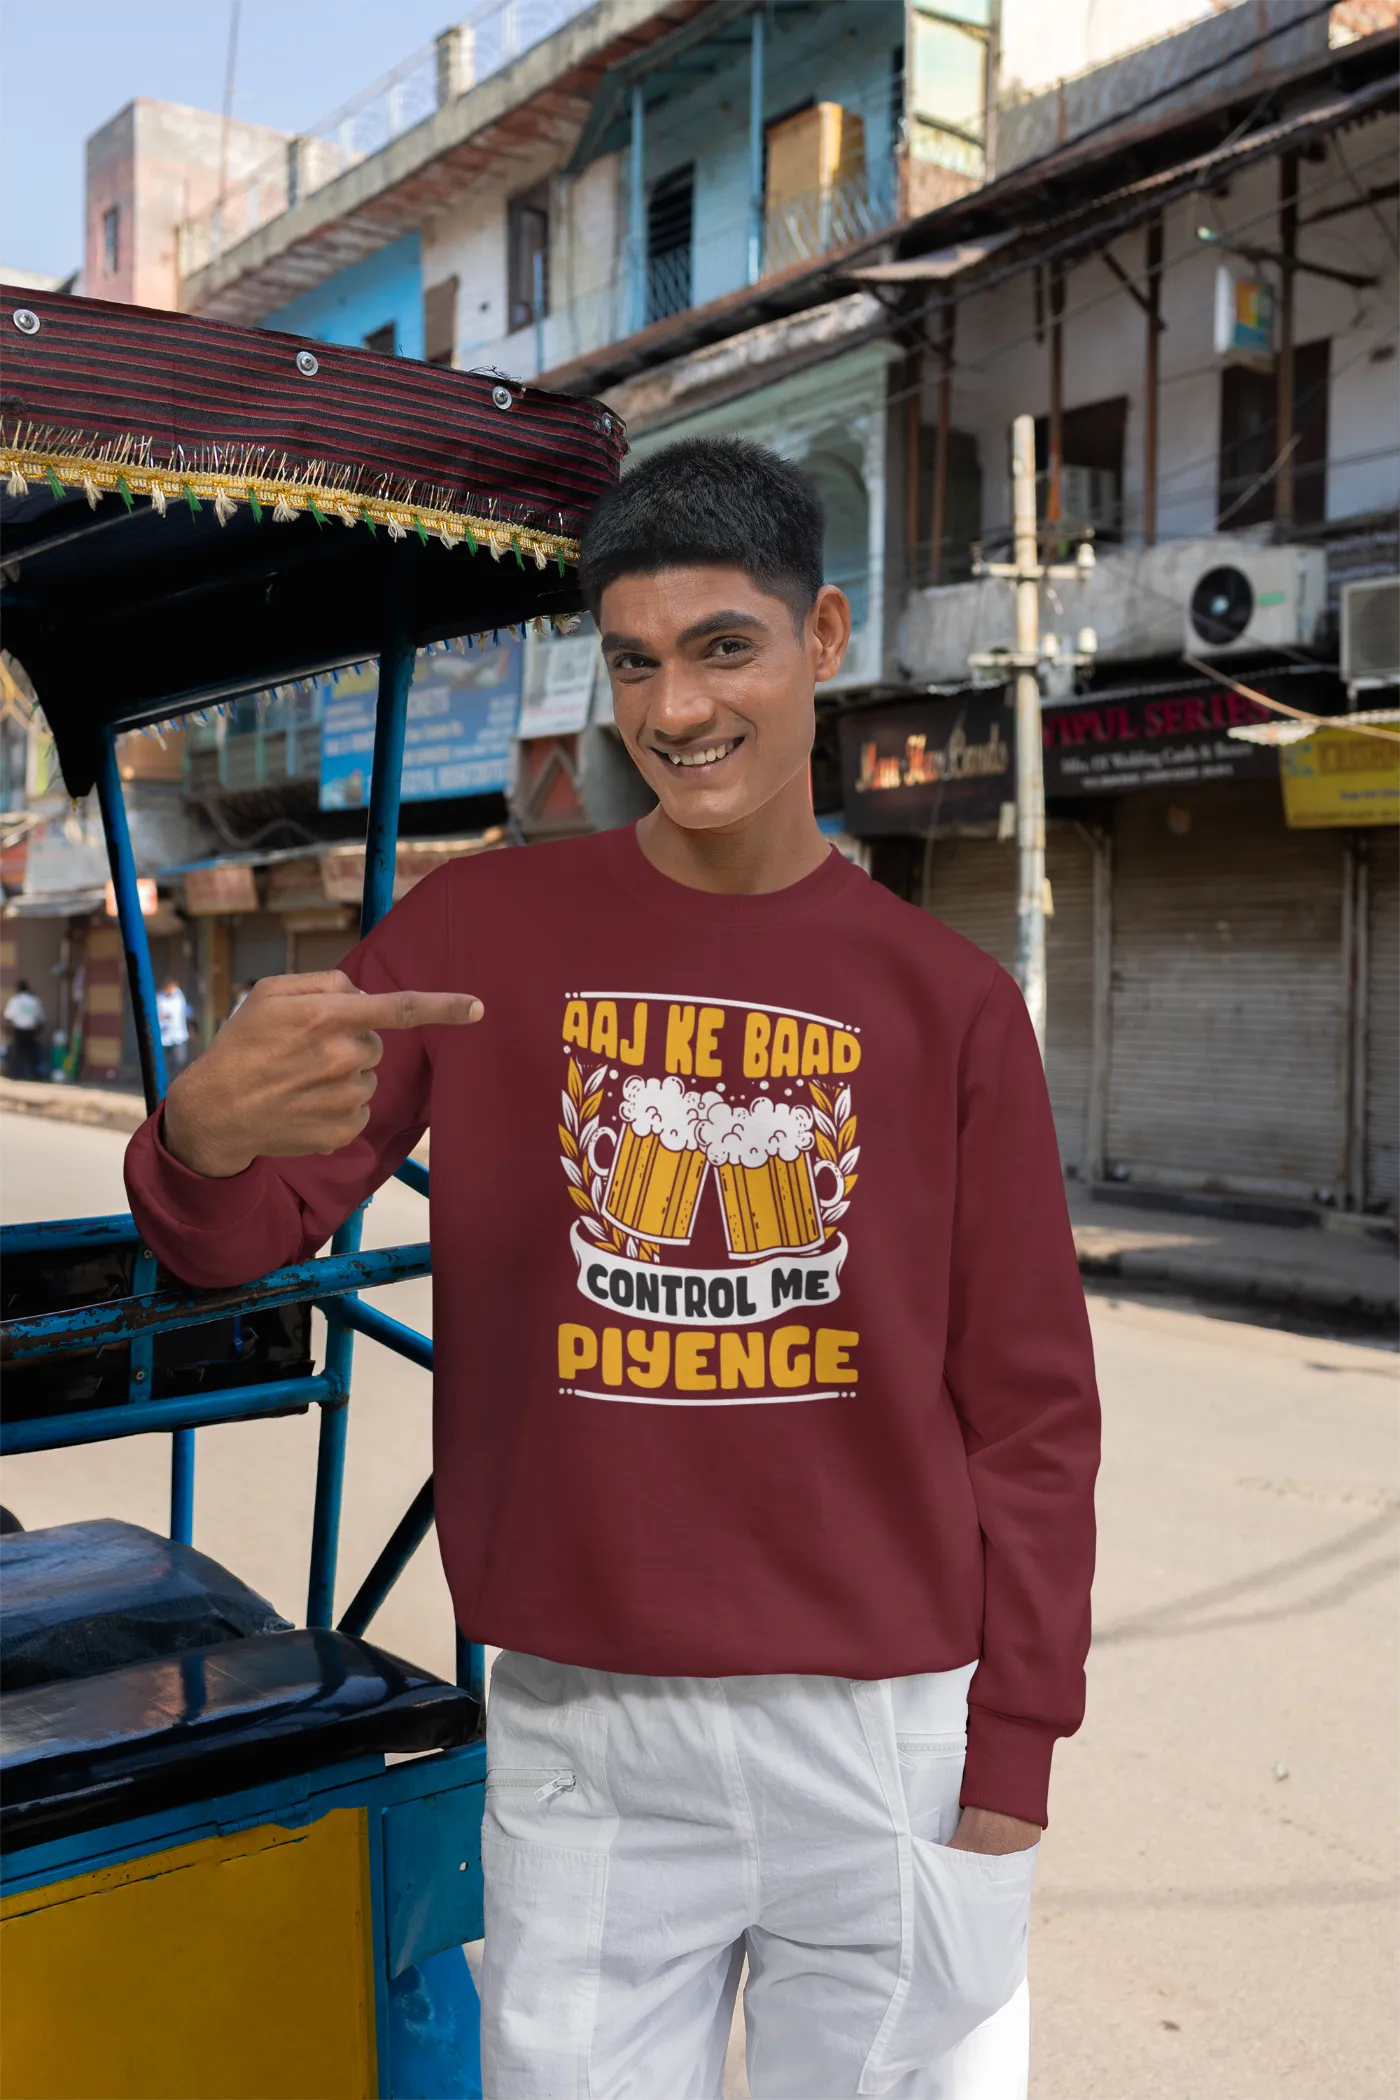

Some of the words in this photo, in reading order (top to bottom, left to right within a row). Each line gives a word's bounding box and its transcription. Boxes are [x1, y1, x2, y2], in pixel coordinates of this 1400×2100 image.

[1144, 688, 1272, 738] SERIES
[562, 1000, 648, 1066] AAJ
[665, 1004, 725, 1078] KE
[743, 1011, 861, 1078] BAAD
[586, 1263, 757, 1319] CONTROL
[771, 1267, 830, 1309] ME
[558, 1323, 859, 1390] PIYENGE
